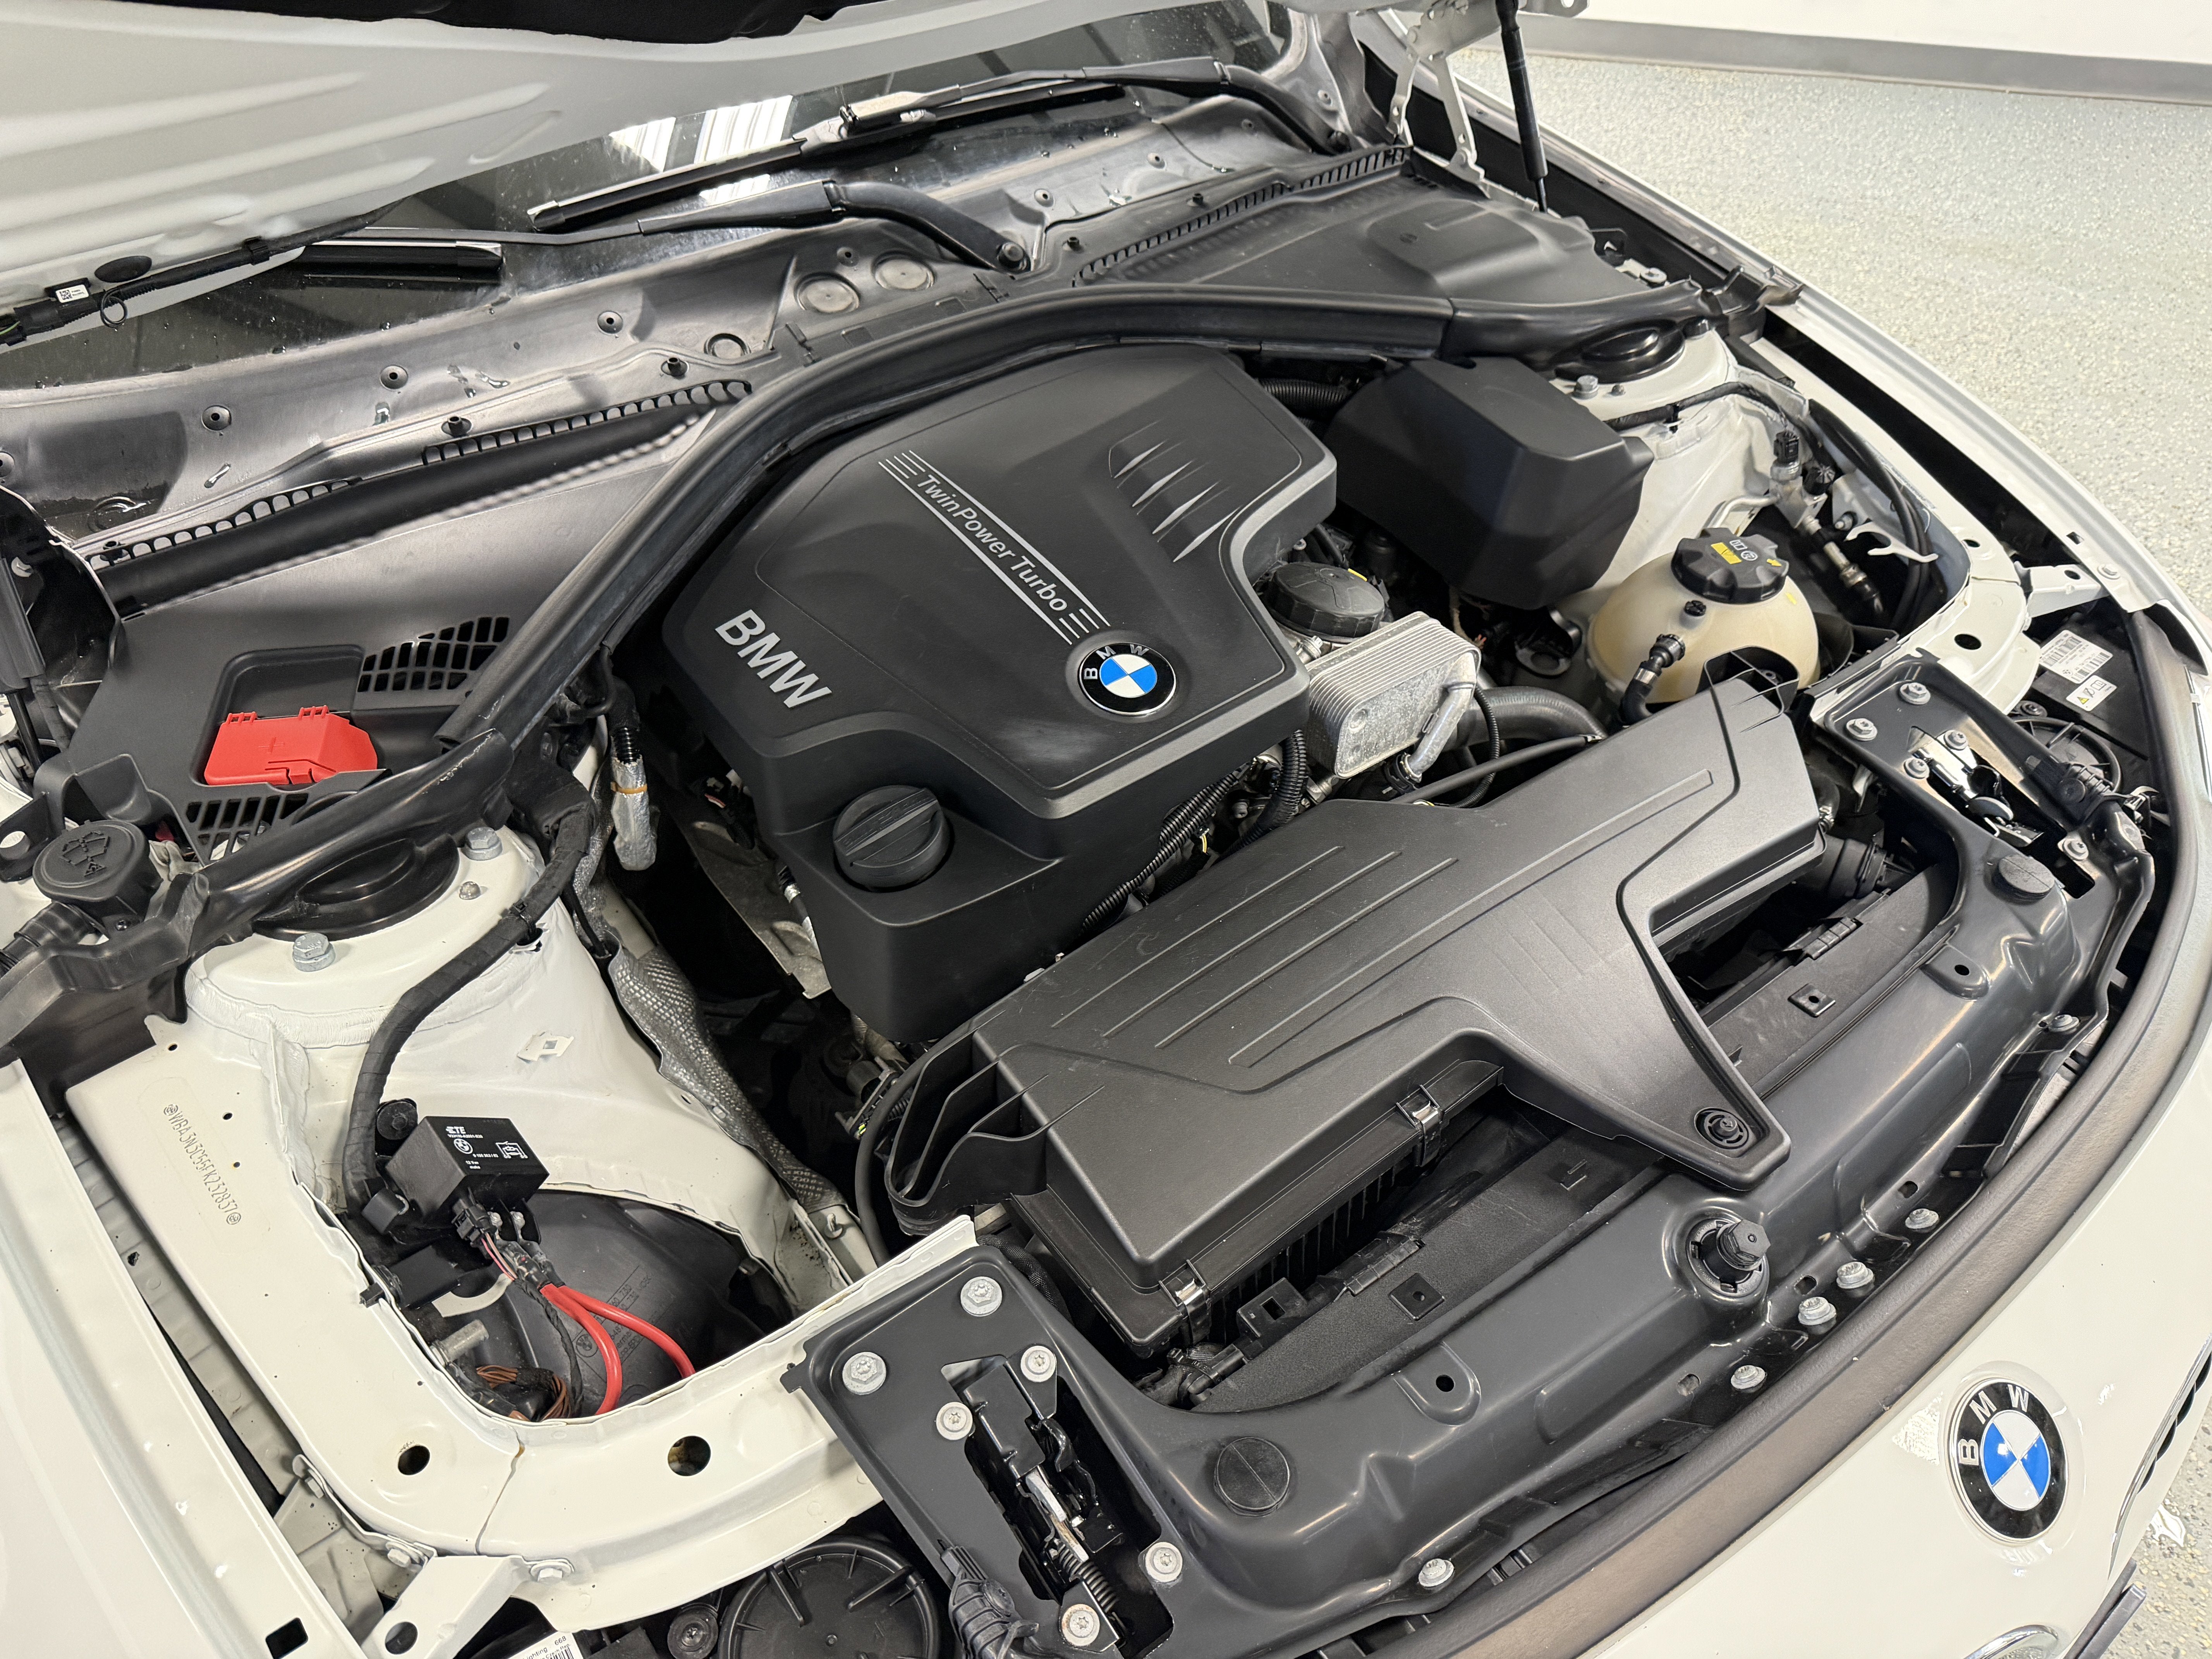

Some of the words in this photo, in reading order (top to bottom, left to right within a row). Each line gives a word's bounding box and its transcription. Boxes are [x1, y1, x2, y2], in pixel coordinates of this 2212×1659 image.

[917, 474, 1015, 558] TwinPower
[1010, 555, 1068, 611] Turbo
[715, 609, 833, 708] BMW
[1083, 644, 1148, 680] BMW
[169, 1111, 238, 1213] WBA3N3C55FK232837
[1958, 1384, 2029, 1466] BMW
[523, 1647, 548, 1659] ighting
[555, 1636, 567, 1645] 668
